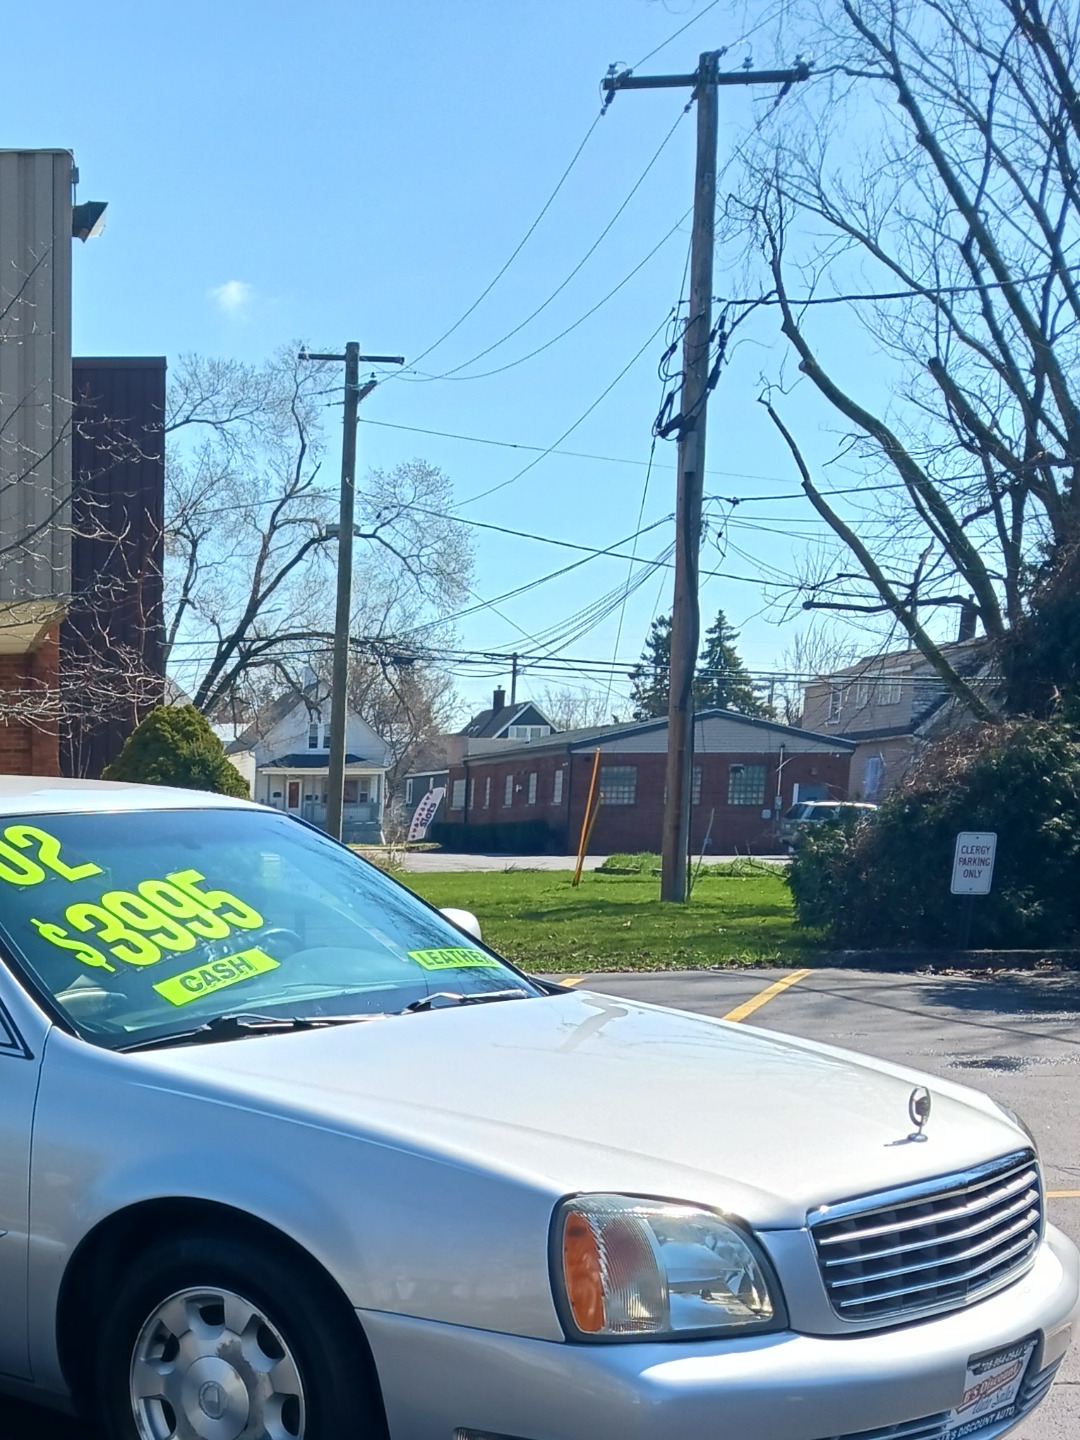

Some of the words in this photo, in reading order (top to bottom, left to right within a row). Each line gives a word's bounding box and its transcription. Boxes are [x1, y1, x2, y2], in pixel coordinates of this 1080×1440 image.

[961, 845, 991, 855] CLERGY
[958, 857, 991, 867] PARKING
[963, 869, 982, 878] ONLY
[30, 869, 264, 973] $3995
[179, 956, 256, 993] CASH
[958, 1413, 995, 1437] DISCOUNT
[993, 1405, 1015, 1422] AUTO
